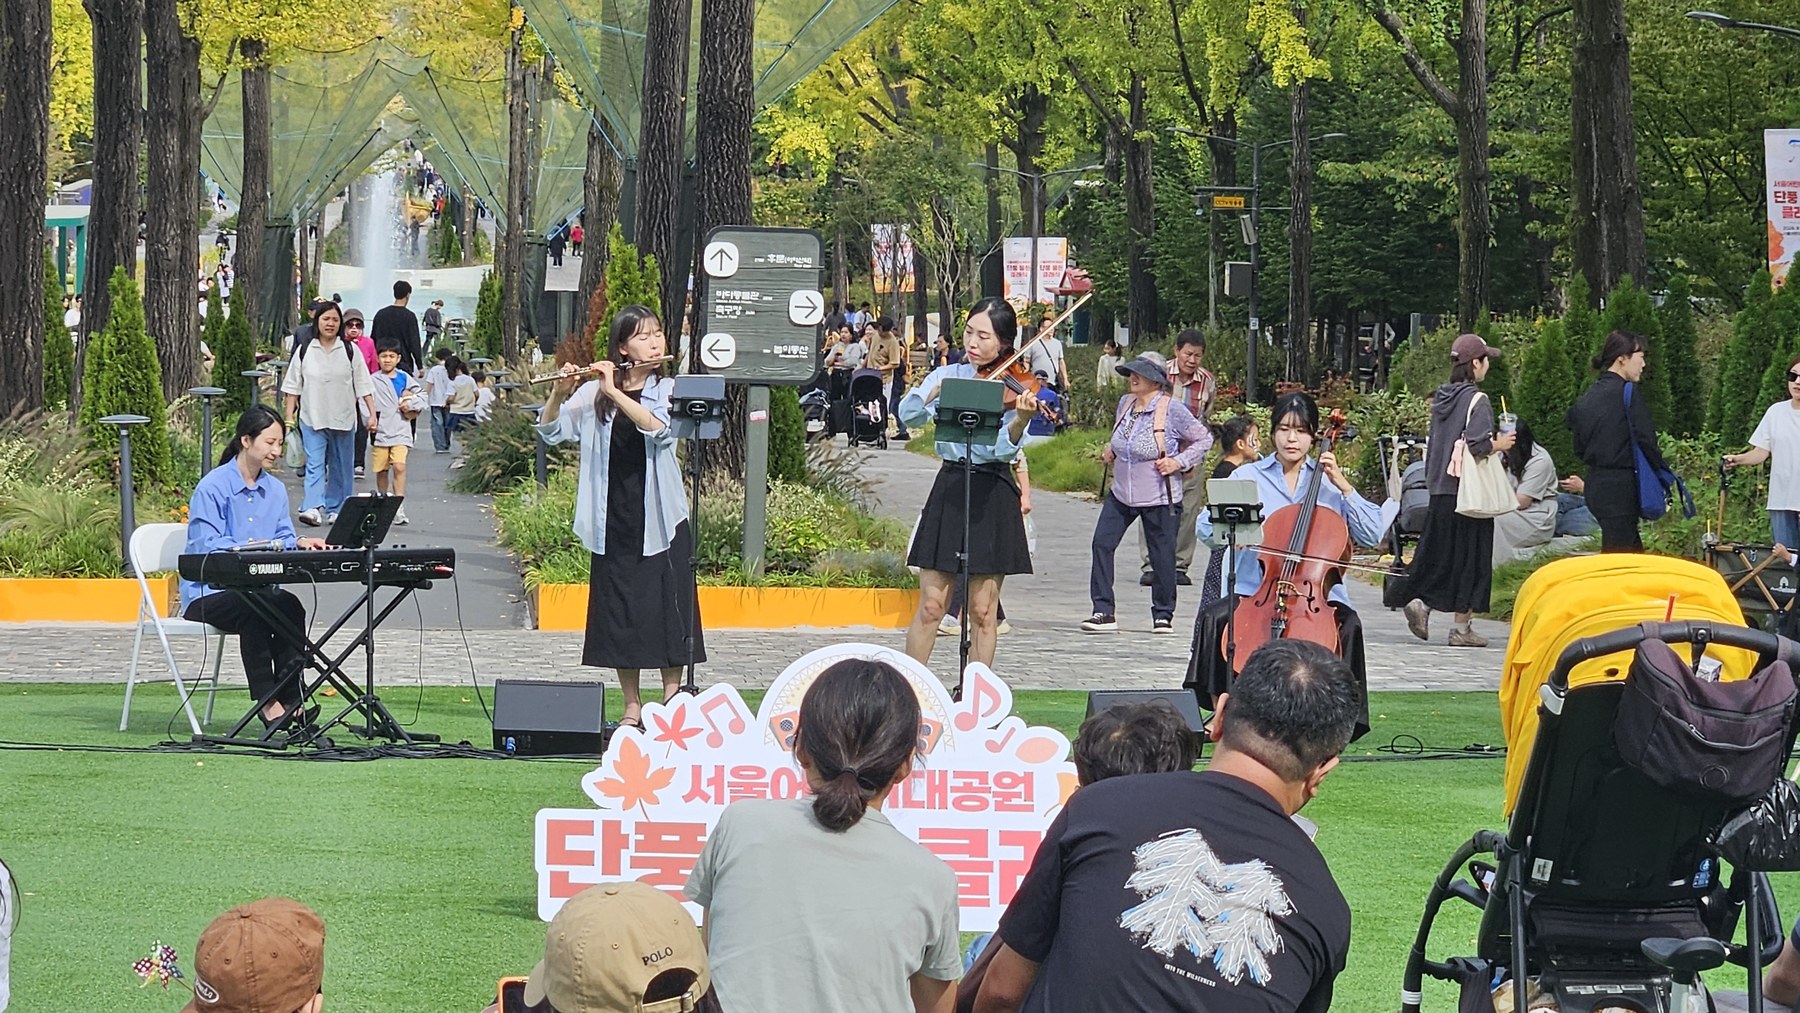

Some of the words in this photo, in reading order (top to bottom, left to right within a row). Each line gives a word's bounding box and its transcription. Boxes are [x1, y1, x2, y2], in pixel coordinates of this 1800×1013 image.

[1773, 190, 1798, 204] 단풍
[257, 563, 284, 574] YAMAHA
[682, 765, 1034, 812] 서울어대공원
[641, 947, 673, 966] POLO
